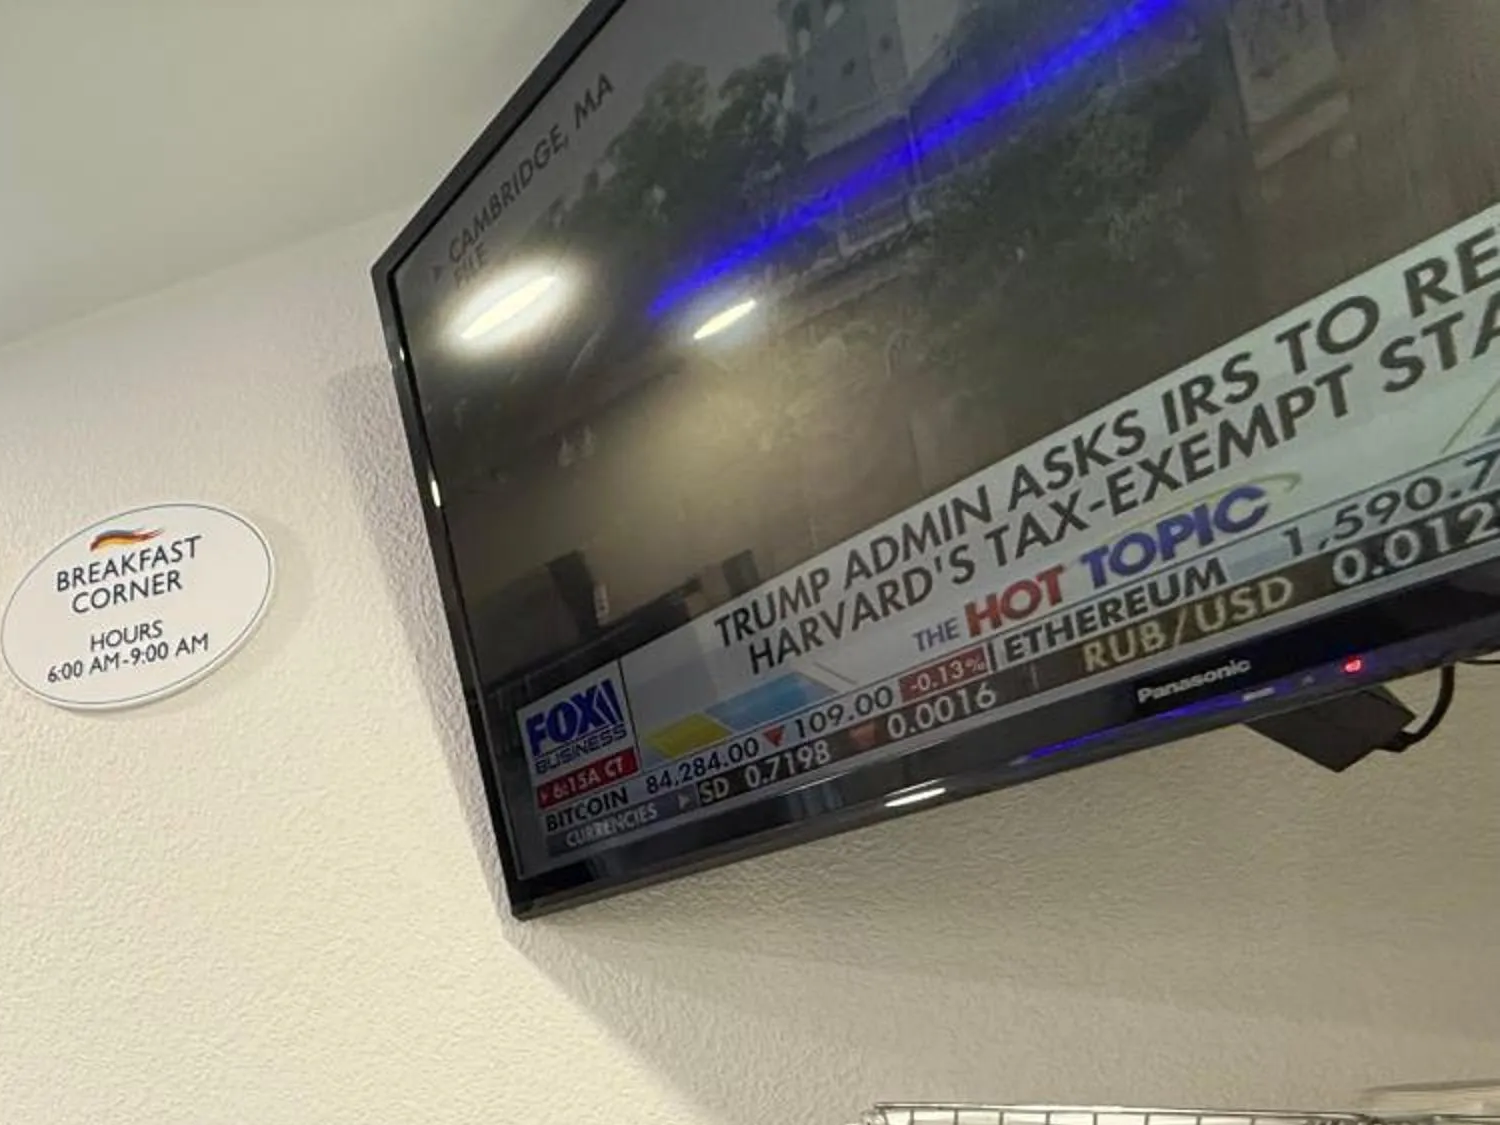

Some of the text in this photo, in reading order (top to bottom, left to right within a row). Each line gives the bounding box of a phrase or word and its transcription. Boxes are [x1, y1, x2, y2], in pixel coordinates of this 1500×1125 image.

[449, 72, 615, 263] CAMBRIDGE, MA
[714, 568, 831, 648] TRUMP
[843, 485, 992, 594] ADMIN
[1008, 409, 1146, 513] ASKS
[1161, 351, 1261, 436] IRS
[1275, 295, 1380, 374] TO
[749, 545, 976, 674] HARVARD'S
[985, 363, 1353, 567] TAX-EXEMPT
[56, 535, 202, 592] BREAKFAST
[71, 569, 183, 614] CORNER
[913, 485, 1268, 654] THE HOT TOPIC
[47, 660, 83, 683] 6:00
[175, 633, 209, 657] AM
[90, 620, 163, 652] HOURS
[545, 786, 629, 832] BITCOIN
[645, 737, 761, 796] 84,284.00
[794, 685, 894, 738] 109.00
[1003, 557, 1228, 663] ETHEREUM
[744, 740, 832, 789] 0.7198
[886, 682, 998, 738] 0.0016
[1082, 576, 1295, 673] RUB/USD
[1137, 658, 1252, 704] Panasonic
[526, 678, 624, 756] FOX
[535, 723, 627, 775] BUSINESS
[604, 757, 624, 779] CT
